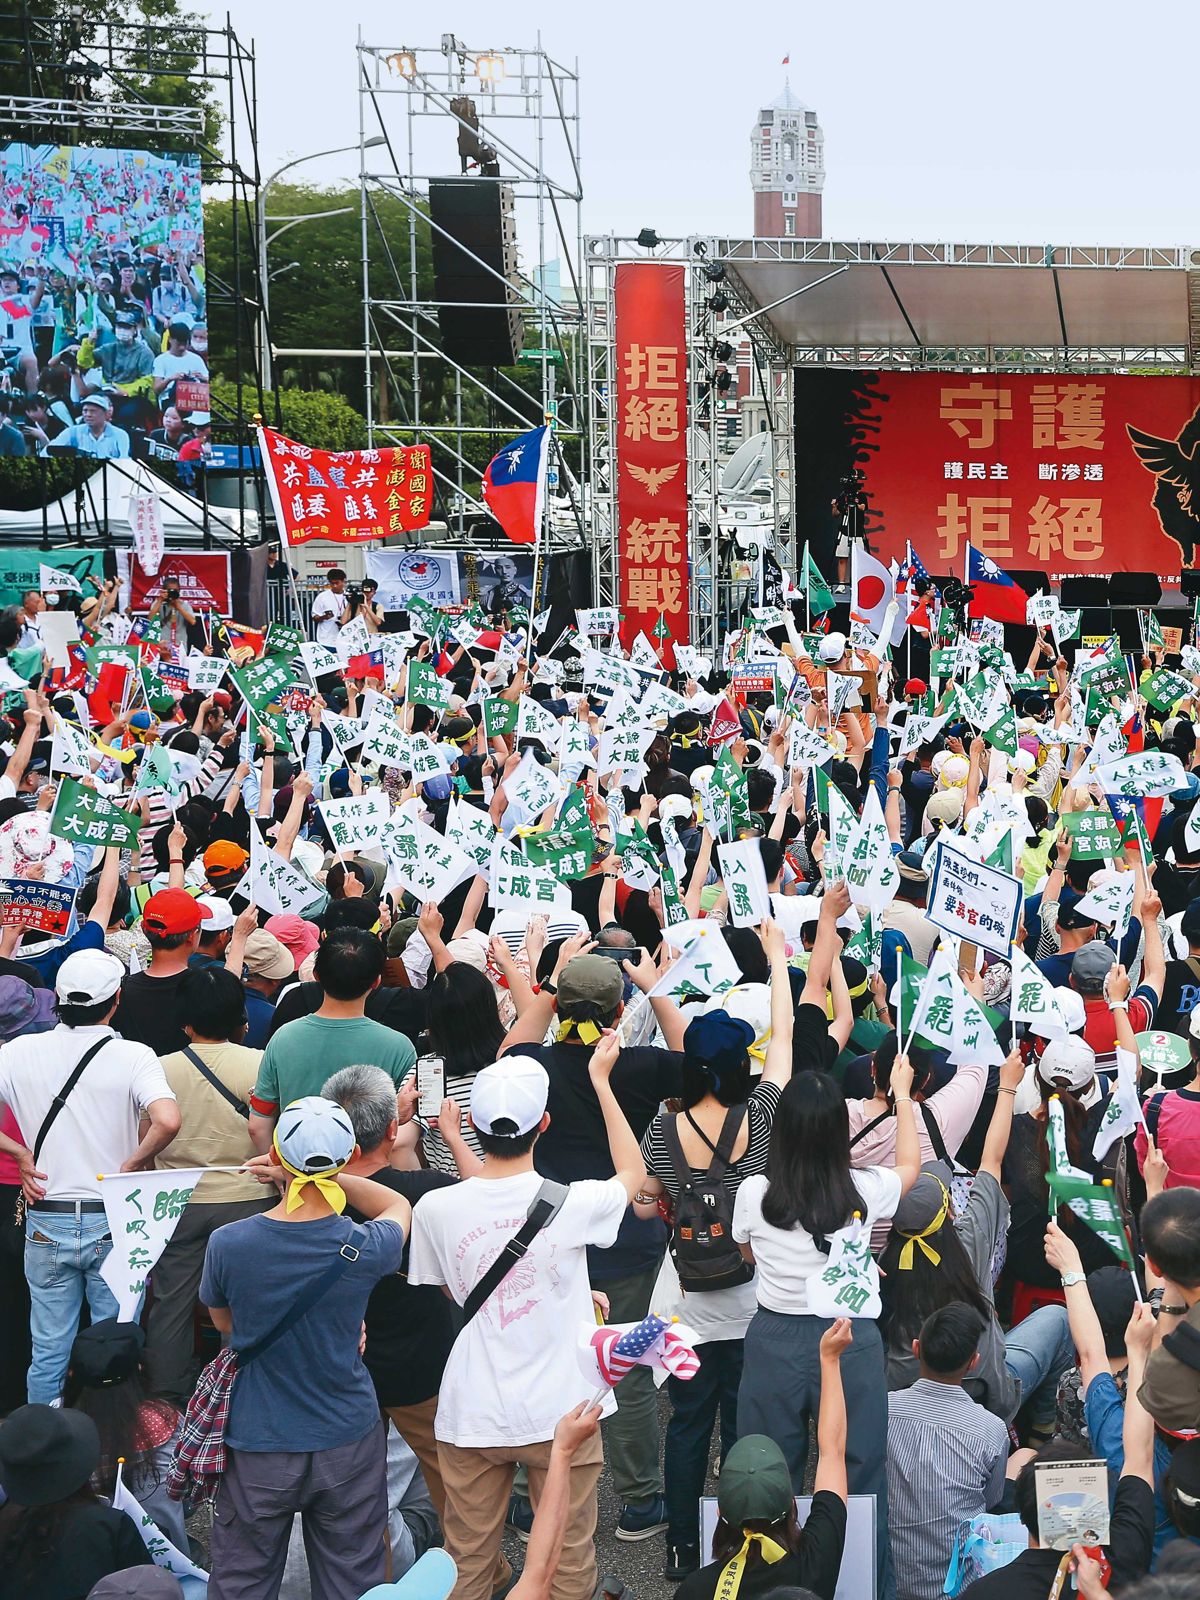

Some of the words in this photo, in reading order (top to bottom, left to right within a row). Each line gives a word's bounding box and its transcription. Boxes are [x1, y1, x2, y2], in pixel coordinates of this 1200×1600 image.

[624, 343, 680, 442] 拒絕
[940, 383, 1105, 449] 守護
[944, 462, 1009, 481] 護民主
[1039, 463, 1104, 481] 斷滲透
[937, 493, 1103, 560] 拒絕
[626, 518, 681, 613] 統戰
[250, 668, 288, 699] 大成宮
[609, 749, 640, 765] 大成
[1113, 756, 1171, 781] 人民作主
[63, 814, 131, 843] 大成宮
[14, 884, 72, 903] 今日不罷免
[3, 907, 43, 919] 日是香港
[1155, 1035, 1166, 1044] 2
